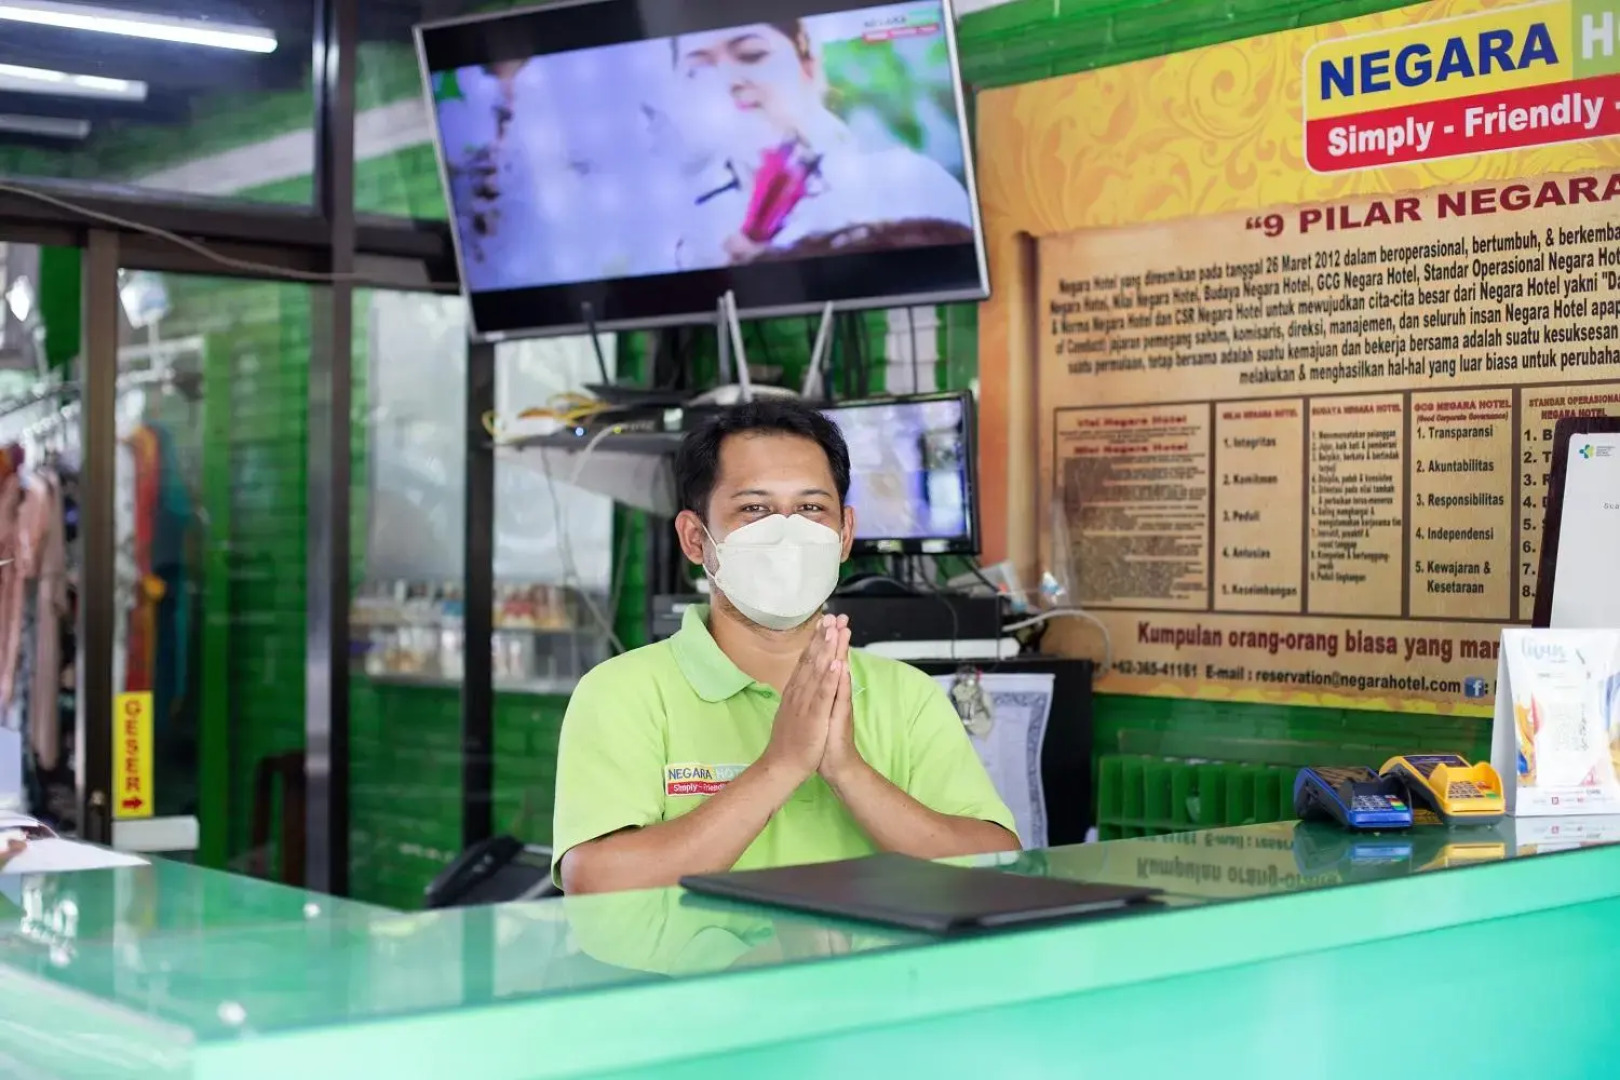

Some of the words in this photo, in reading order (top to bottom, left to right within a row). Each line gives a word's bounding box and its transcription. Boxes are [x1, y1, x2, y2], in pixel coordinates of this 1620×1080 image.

[1320, 22, 1559, 100] NEGARA
[1582, 11, 1620, 59] H
[1328, 116, 1434, 157] Simply
[1443, 125, 1454, 134] -
[1465, 93, 1604, 138] Friendly
[1300, 198, 1422, 233] PILAR
[1438, 174, 1620, 218] NEGARA
[1199, 263, 1222, 284] pada
[1226, 258, 1263, 281] tanggal
[1266, 256, 1279, 274] 26
[1282, 254, 1312, 273] Maret
[1315, 250, 1340, 269] 2012
[1344, 247, 1377, 266] dalam
[1380, 236, 1469, 264] beroperasional,
[1472, 230, 1541, 254] bertumbuh,
[1545, 228, 1554, 247] &
[1204, 284, 1240, 302] Budaya
[1243, 281, 1280, 301] Negara
[1317, 271, 1341, 291] GCG
[1344, 270, 1384, 292] Negara
[1387, 265, 1420, 285] Hotel,
[1424, 260, 1469, 282] Standar
[1472, 252, 1545, 280] Operasional
[1549, 251, 1594, 273] Negara
[1175, 307, 1195, 325] CSR
[1198, 306, 1233, 327] Negara
[1236, 301, 1263, 319] Hotel
[1266, 299, 1295, 317] untuk
[1298, 294, 1365, 317] mewujudkan
[1368, 289, 1415, 309] cita-cita
[1418, 286, 1450, 306] besar
[1454, 283, 1476, 303] dari
[1480, 280, 1524, 304] Negara
[1528, 275, 1560, 297] Hotel
[1564, 271, 1598, 298] yakni
[1144, 332, 1192, 351] pemegang
[1233, 322, 1284, 342] komisaris,
[1287, 319, 1327, 338] direksi,
[1330, 315, 1396, 338] manajemen,
[1399, 312, 1420, 330] dan
[1423, 308, 1466, 328] seluruh
[1470, 305, 1502, 325] insan
[1505, 303, 1550, 326] Negara
[1554, 297, 1588, 318] Hotel
[1175, 350, 1218, 367] bersama
[1220, 347, 1254, 364] adalah
[1257, 344, 1285, 362] suatu
[1288, 340, 1338, 362] kemajuan
[1342, 338, 1362, 357] dan
[1365, 335, 1406, 358] bekerja
[1410, 333, 1459, 352] bersama
[1463, 327, 1502, 349] adalah
[1506, 326, 1540, 347] suatu
[1544, 322, 1618, 344] kesuksesan
[1239, 366, 1295, 384] melakukan
[1298, 363, 1306, 381] &
[1310, 360, 1385, 384] menghasilkan
[1388, 355, 1426, 377] hal-hal
[1429, 356, 1456, 379] yang
[1460, 353, 1482, 373] luar
[1486, 351, 1518, 371] biasa
[1522, 348, 1557, 368] untuk
[1436, 400, 1476, 412] NEGARA
[1479, 398, 1511, 410] HOTEL
[1529, 397, 1565, 408] STANDAR
[1417, 428, 1425, 440] 1.
[1428, 424, 1493, 442] Transparansi
[1524, 429, 1537, 442] 1.
[1417, 460, 1425, 473] 2.
[1428, 457, 1494, 473] Akuntabilitas
[1523, 452, 1537, 464] 2.
[1523, 473, 1537, 486] 3.
[1416, 494, 1425, 507] 3.
[1428, 492, 1504, 509] Responsibilitas
[1523, 496, 1536, 509] 4.
[1523, 518, 1536, 531] 5.
[1416, 528, 1424, 540] 4.
[1427, 526, 1494, 542] Independensi
[1522, 540, 1536, 553] 6.
[1415, 561, 1424, 574] 5.
[1427, 560, 1480, 577] Kewajaran
[1484, 561, 1491, 575] &
[1522, 563, 1536, 576] 7.
[1232, 583, 1298, 598] Keseimbangan
[1427, 579, 1484, 594] Kesetaraan
[1138, 621, 1222, 650] Kumpulan
[1228, 629, 1338, 658] orang-orang
[1345, 629, 1398, 655] biasa
[1404, 636, 1453, 662] yang
[1206, 663, 1244, 681] E-mail
[125, 700, 141, 792] GESER
[668, 767, 713, 780] NEGARA
